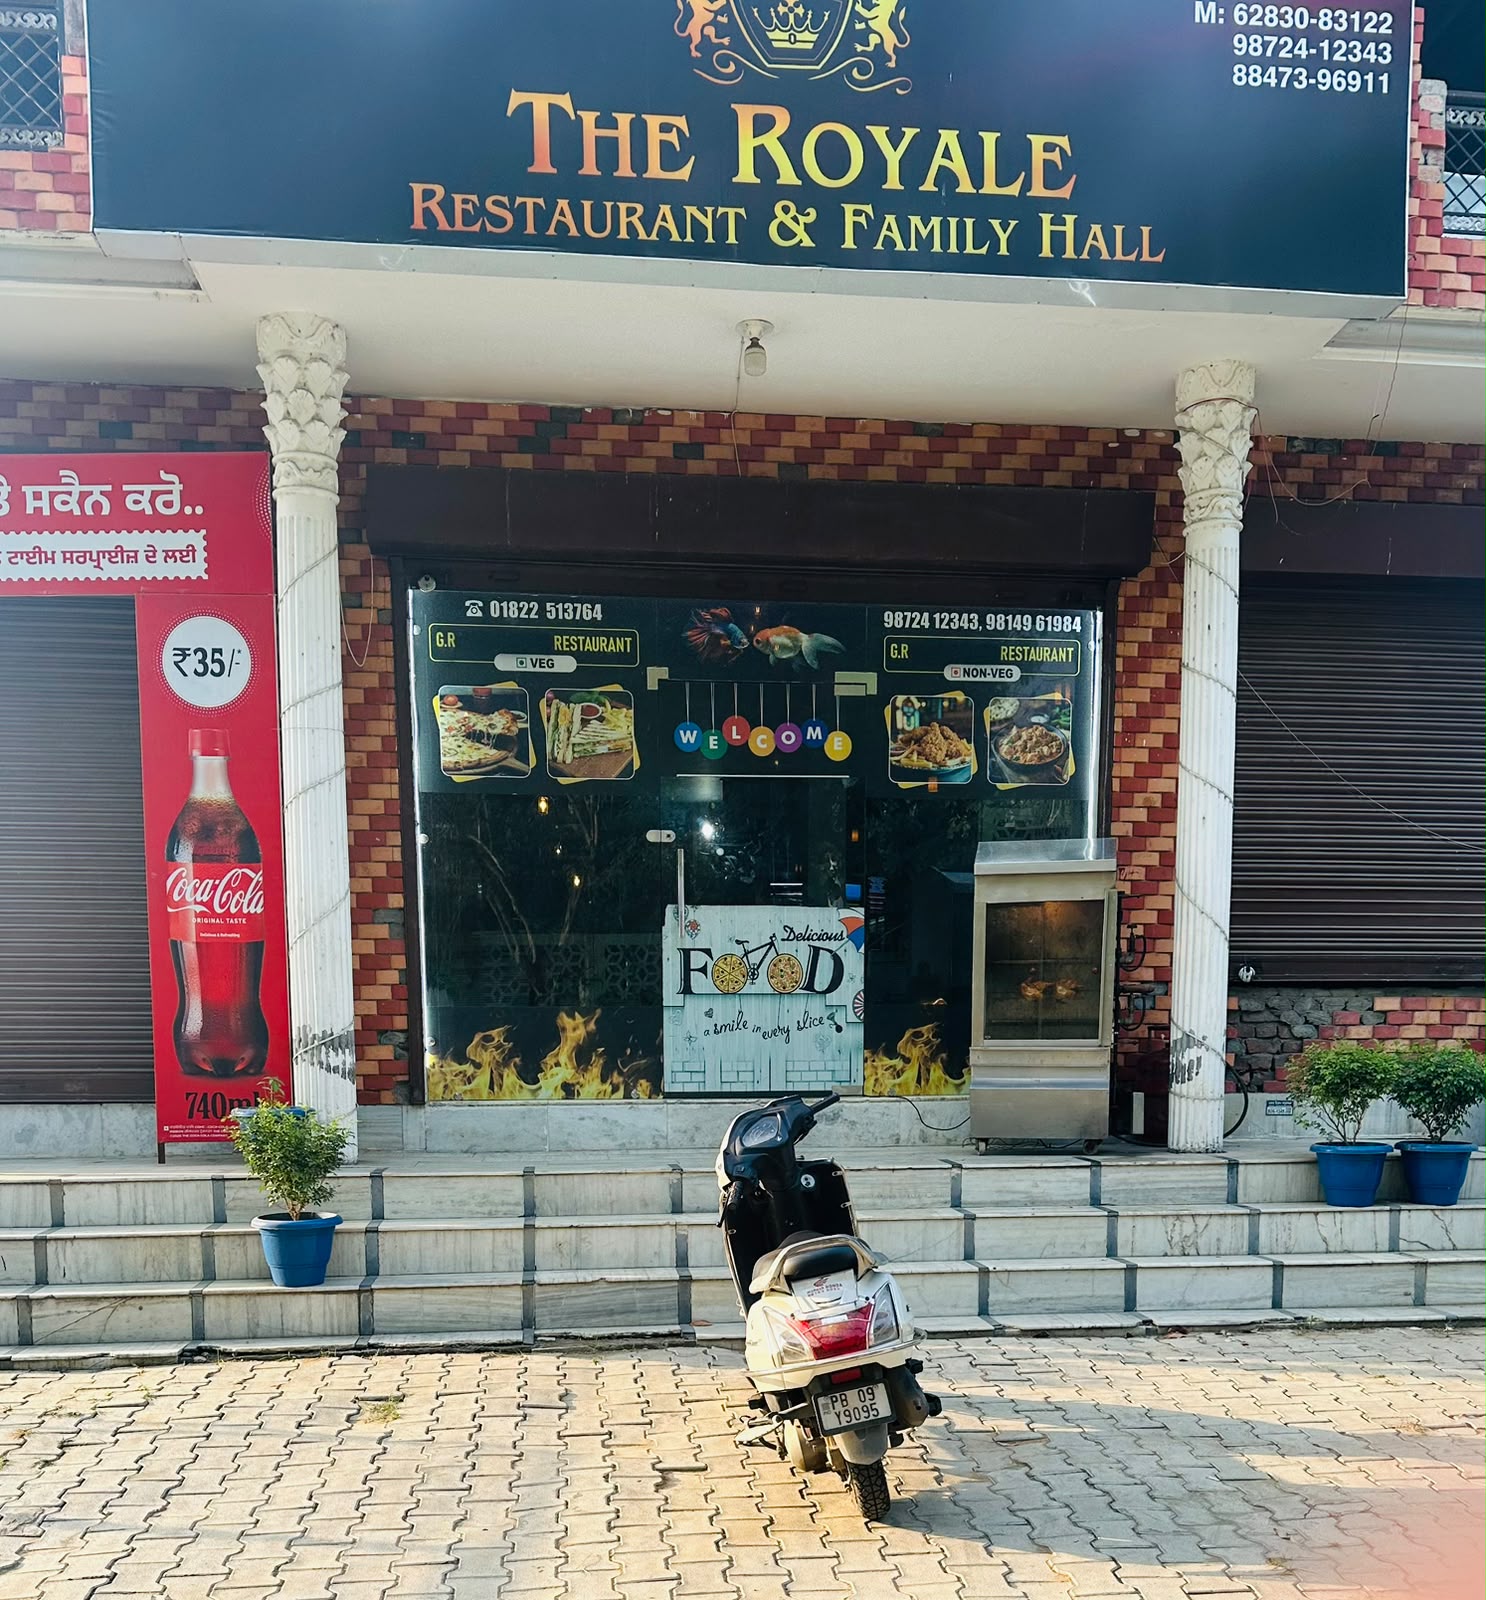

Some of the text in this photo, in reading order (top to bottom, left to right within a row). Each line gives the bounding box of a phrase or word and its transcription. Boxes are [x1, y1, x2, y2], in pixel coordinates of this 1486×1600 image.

[1194, 1, 1394, 34] M: 62830-83122
[1232, 34, 1393, 64] 98724-12343
[1231, 64, 1390, 94] 88473-96911
[505, 88, 1077, 200] THE ROYALE
[408, 182, 1167, 264] RESTAURANT & FAMILY HALL
[22, 469, 113, 517] ਸਕੈਨ
[6, 545, 57, 566] ਟਾਈਮ
[144, 544, 158, 564] ਦੇ
[162, 544, 197, 564] ਲਈ
[489, 601, 603, 621] 01822 513764
[883, 611, 1082, 633] 98724 12343, 98149 61984
[436, 632, 632, 653] G.R RESTAURANT
[890, 643, 1074, 663] G.R RESTAURANT
[530, 658, 555, 669] VEG
[962, 667, 1014, 679] NON-VEG
[677, 723, 845, 752] WELCOME
[780, 924, 846, 942] Delicious
[703, 1010, 825, 1044] a smile in every slice
[830, 1386, 875, 1411] PB 09
[834, 1402, 880, 1426] Y9095
